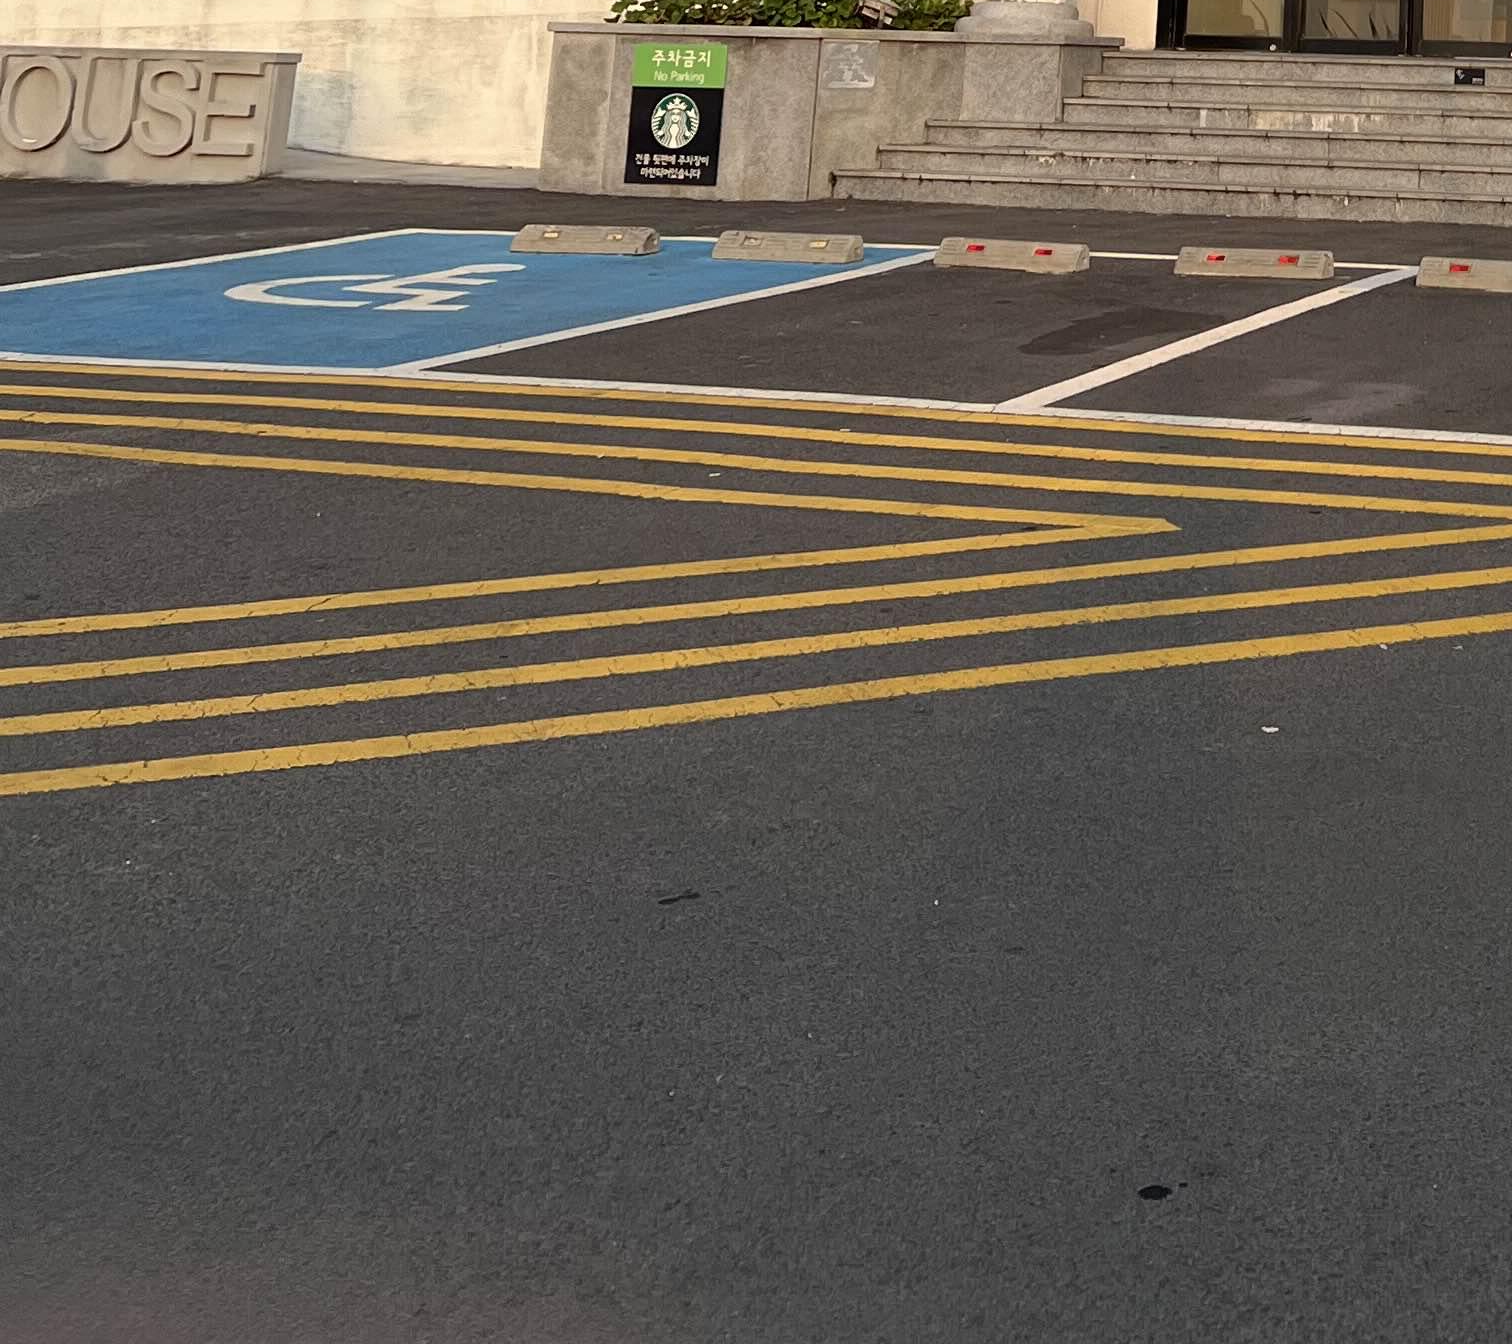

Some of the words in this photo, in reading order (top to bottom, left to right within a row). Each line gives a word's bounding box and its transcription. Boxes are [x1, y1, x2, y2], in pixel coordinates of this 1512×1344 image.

[651, 49, 712, 68] 주차금지
[654, 70, 669, 82] No
[670, 70, 705, 85] Parking
[0, 55, 265, 158] OUSE
